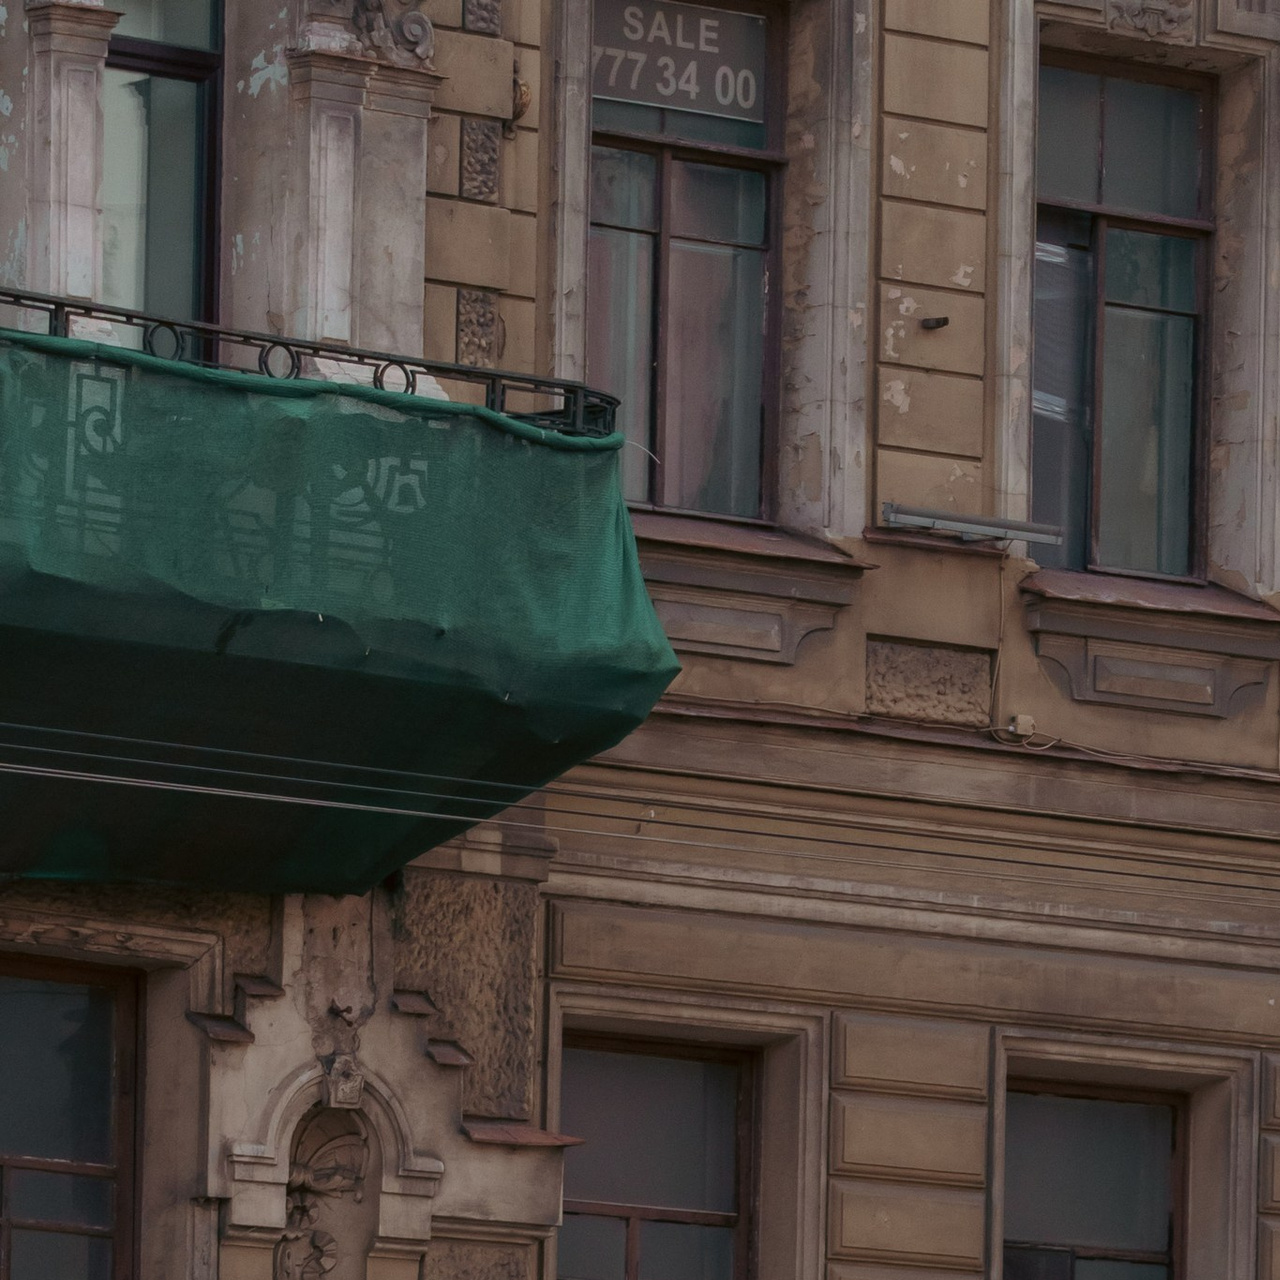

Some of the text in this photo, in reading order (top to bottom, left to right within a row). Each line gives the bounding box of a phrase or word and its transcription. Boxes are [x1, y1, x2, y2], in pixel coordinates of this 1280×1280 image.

[623, 5, 720, 54] SALE
[656, 56, 700, 100] 34
[715, 65, 757, 109] 00
